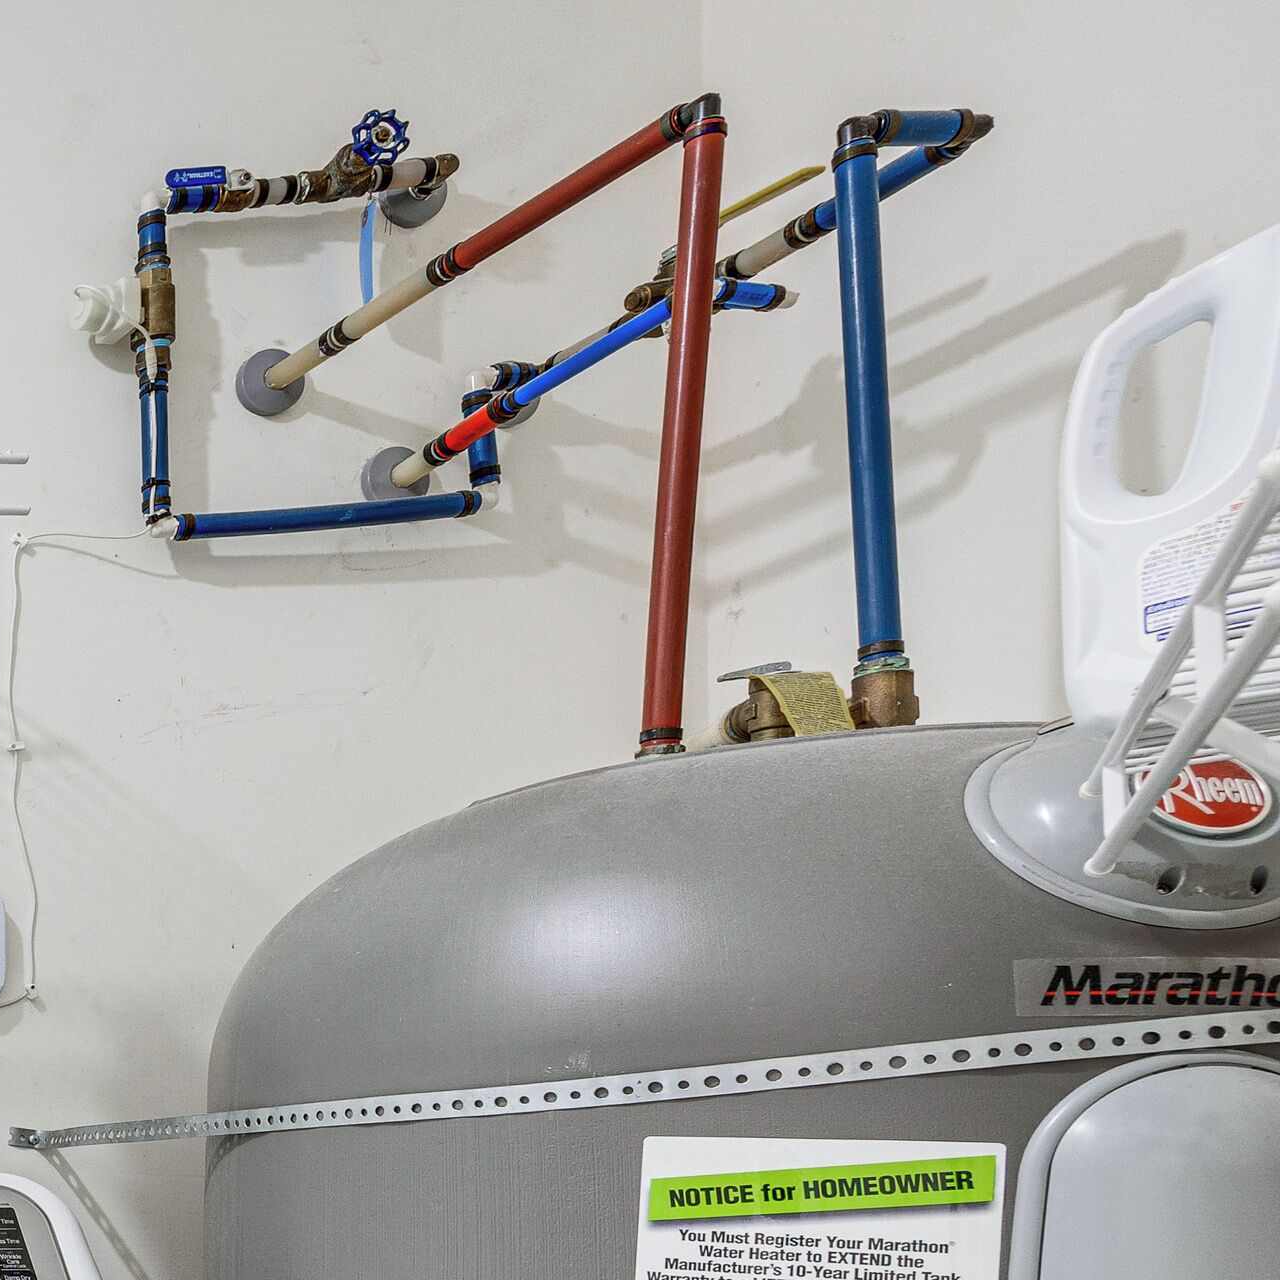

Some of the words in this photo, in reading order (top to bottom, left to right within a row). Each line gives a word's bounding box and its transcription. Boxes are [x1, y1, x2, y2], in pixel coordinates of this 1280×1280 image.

[1140, 764, 1264, 814] Rheem
[669, 1185, 754, 1207] NOTICE
[761, 1183, 795, 1202] for
[803, 1170, 974, 1200] HOMEOWNER
[679, 1230, 707, 1244] You
[711, 1231, 749, 1244] Must
[754, 1233, 822, 1251] Register
[826, 1236, 863, 1250] Your
[699, 1246, 745, 1259] Water
[750, 1247, 801, 1262] Heater
[806, 1251, 822, 1262] to
[827, 1253, 891, 1267] EXTEND
[896, 1255, 924, 1268] the
[787, 1265, 849, 1280] 10-Year
